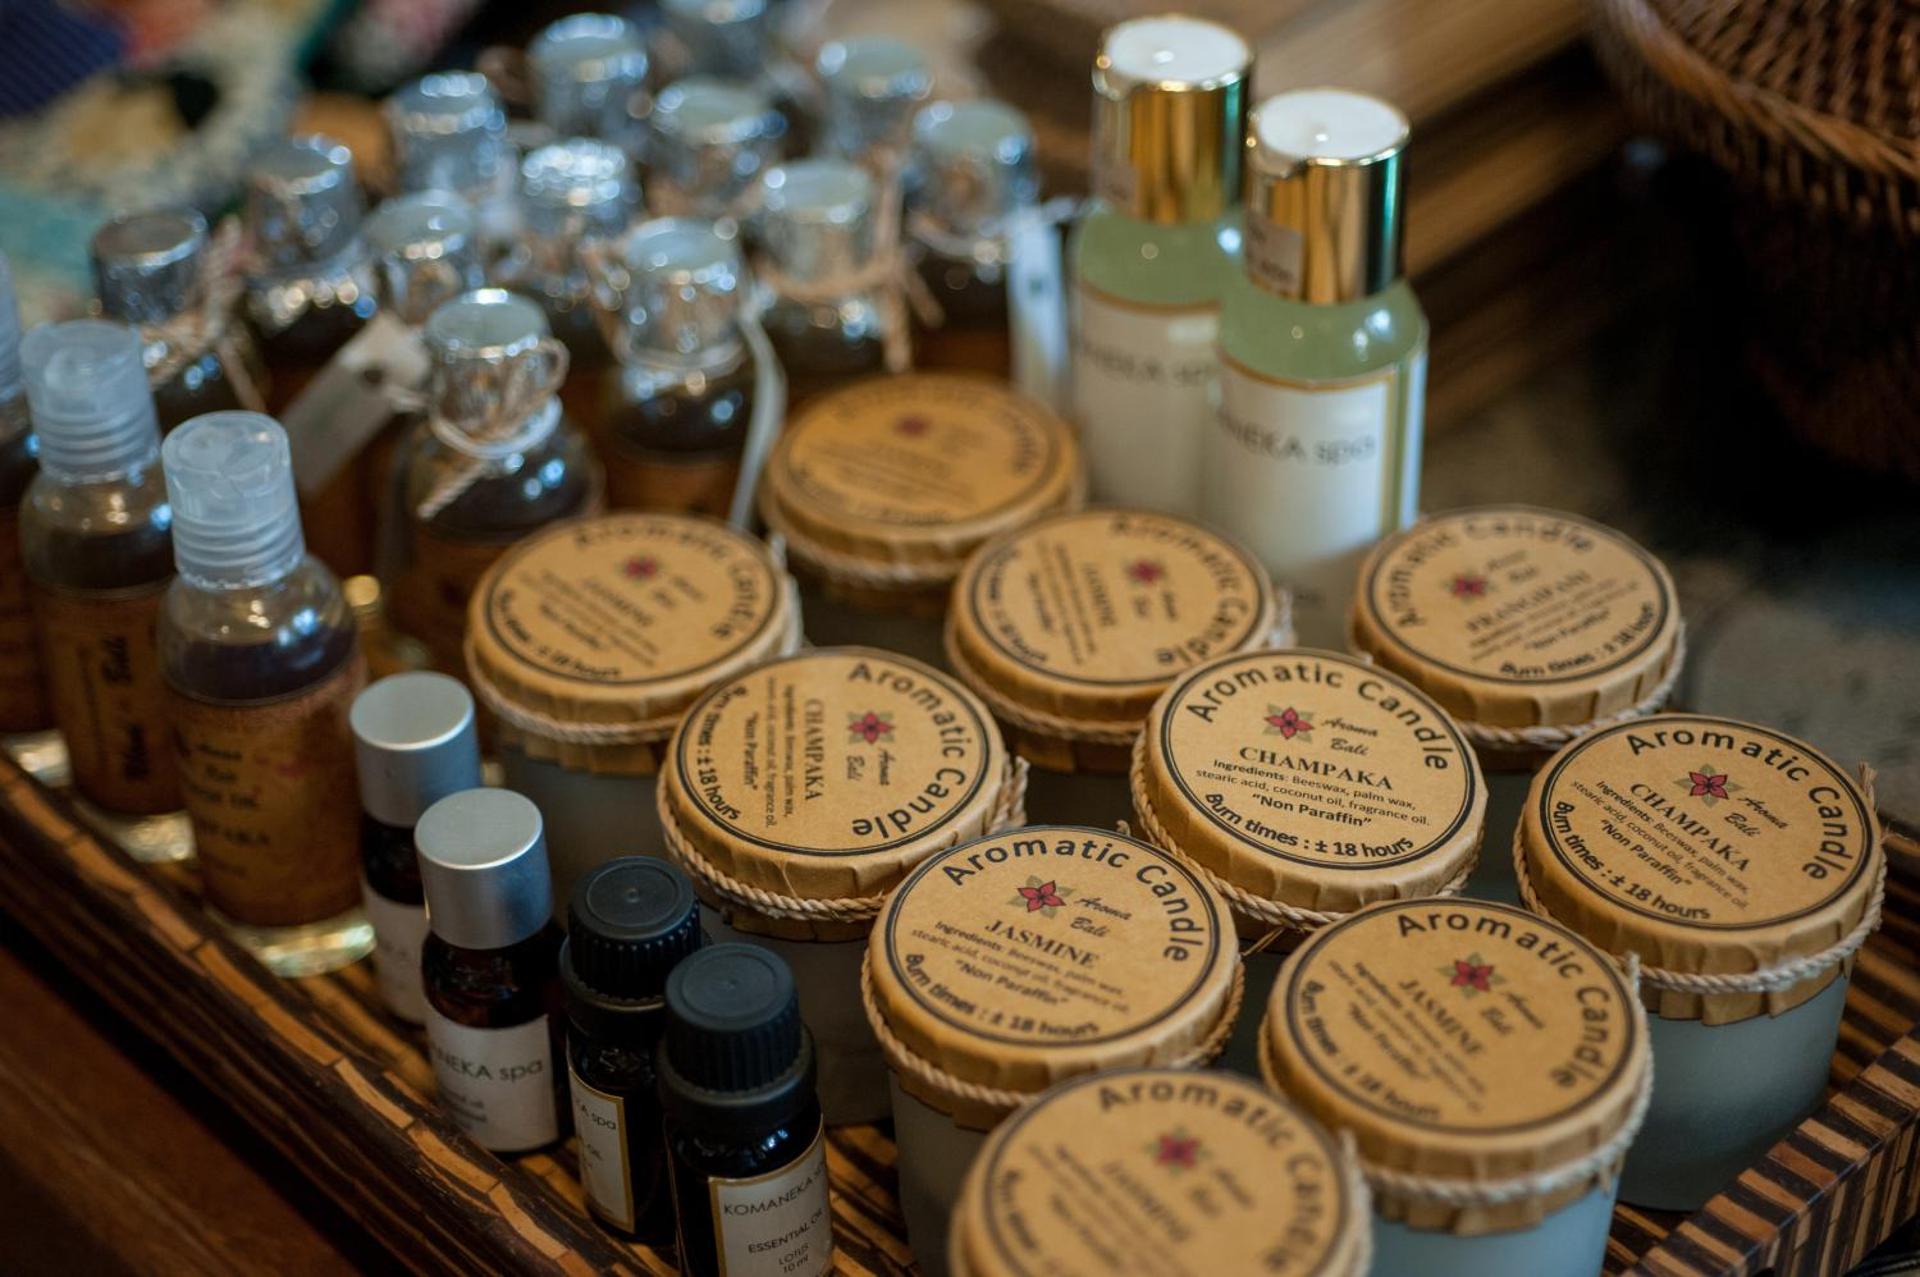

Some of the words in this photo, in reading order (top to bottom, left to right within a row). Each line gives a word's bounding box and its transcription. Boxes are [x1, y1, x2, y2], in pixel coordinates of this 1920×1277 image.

[848, 661, 972, 759] Aromatic
[1186, 661, 1344, 724] Aromatic
[1357, 679, 1454, 771] Candle
[804, 699, 824, 801] CHAMPAKA
[1239, 746, 1393, 790] CHAMPAKA
[699, 768, 718, 785] 18
[1195, 768, 1238, 785] stearic
[1240, 777, 1269, 794] acid,
[1273, 784, 1323, 802] coconut
[1326, 794, 1346, 808] oil,
[1349, 799, 1409, 821] fragrance
[1411, 814, 1430, 827] oil.
[1213, 759, 1286, 782] Ingredients:
[1292, 774, 1350, 796] Beeswax,
[1353, 789, 1385, 804] palm
[1387, 797, 1416, 811] wax,
[704, 784, 741, 820] hours
[852, 766, 966, 839] Candle
[1205, 792, 1243, 825] Burn
[1245, 819, 1298, 846] times
[1333, 841, 1358, 858] 18
[1362, 837, 1414, 858] hours
[1553, 801, 1576, 834] Burn
[1626, 728, 1810, 783] Aromatic
[1802, 785, 1854, 881] Candle
[1564, 833, 1605, 871] times
[1571, 780, 1604, 807] stearic
[1627, 821, 1669, 852] coconut
[1684, 860, 1733, 900] fragrance
[1630, 783, 1750, 872] CHAMPAKA
[1625, 882, 1652, 901] 18
[1699, 856, 1727, 877] palm
[942, 838, 1131, 886] Aromatic
[1136, 863, 1205, 963] Candle
[1651, 895, 1711, 920] hours
[985, 920, 1099, 968] JASMINE
[905, 953, 930, 987] Burn
[1397, 912, 1584, 980] Aromatic
[1551, 985, 1610, 1087] Candle
[1398, 979, 1483, 1054] JASMINE
[500, 1060, 543, 1083] spa
[723, 1177, 813, 1216] KOMANEKA
[748, 1222, 811, 1254] ESSENTIAL
